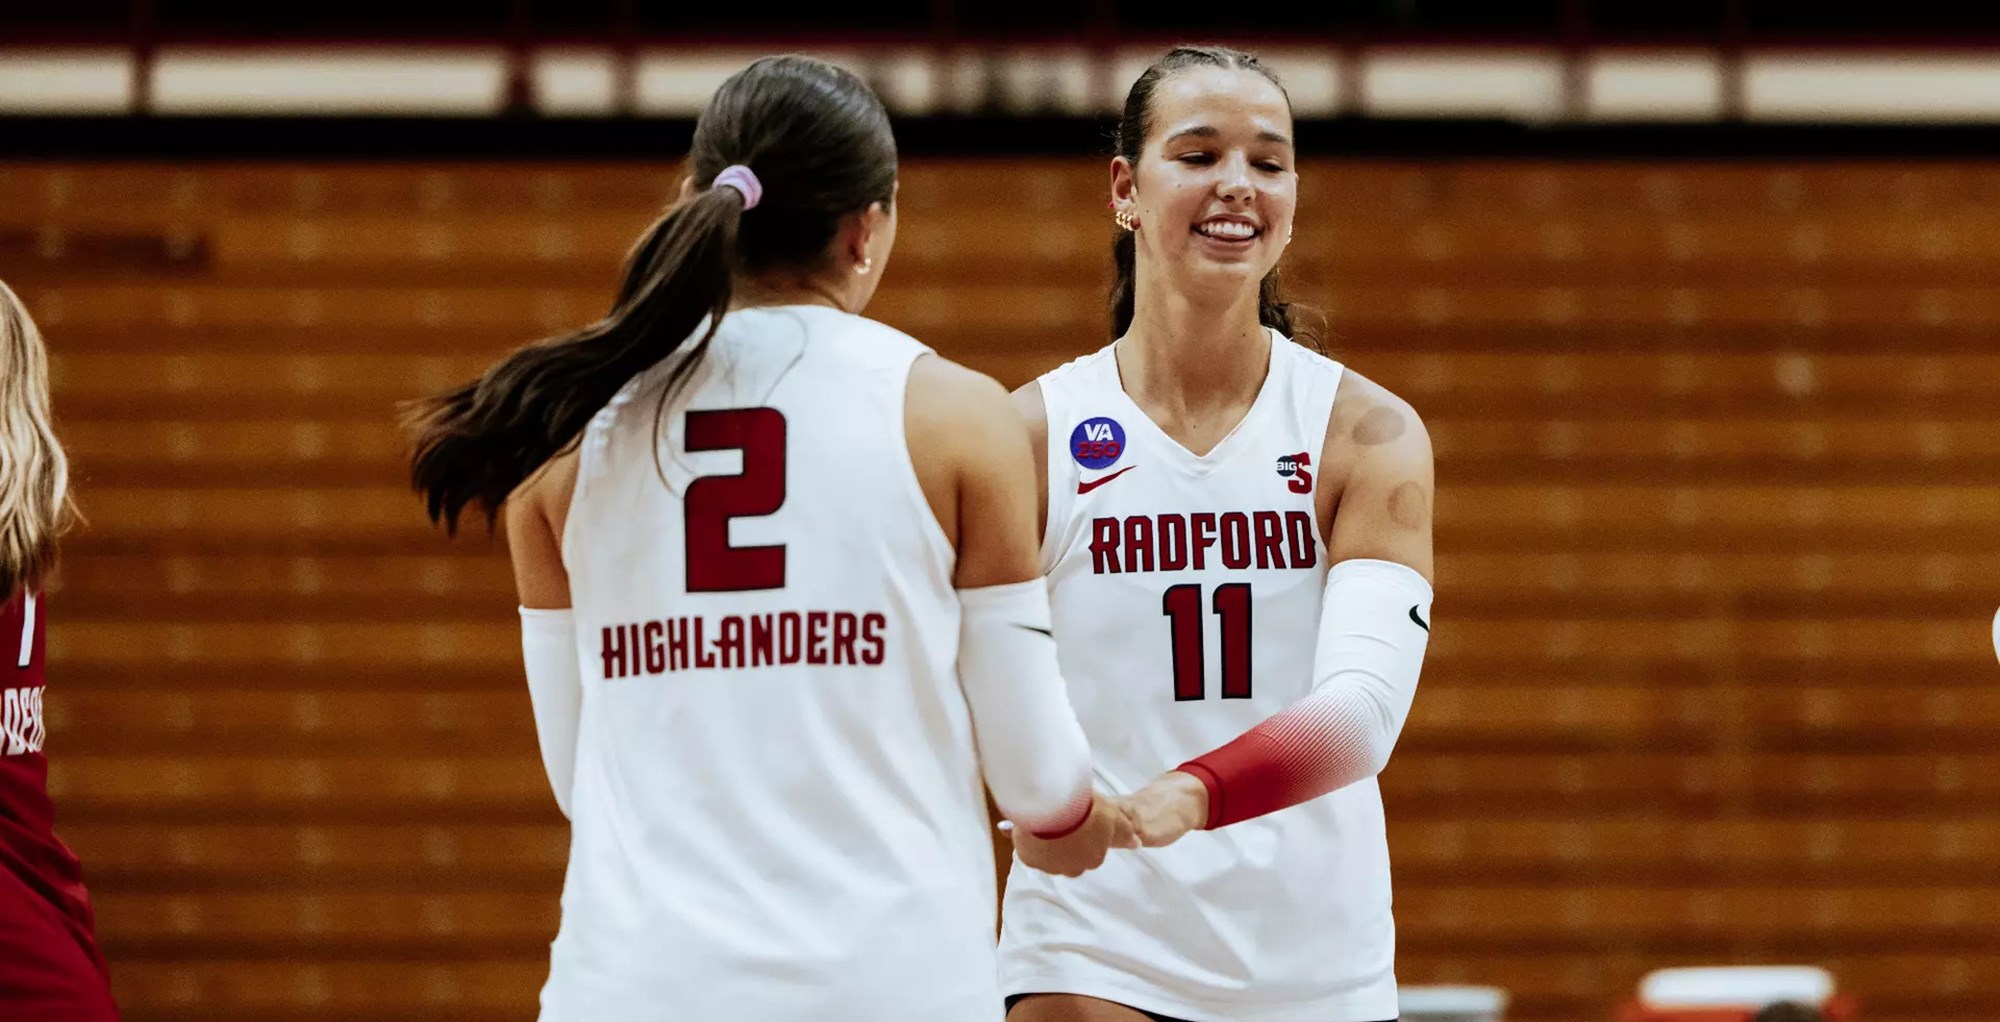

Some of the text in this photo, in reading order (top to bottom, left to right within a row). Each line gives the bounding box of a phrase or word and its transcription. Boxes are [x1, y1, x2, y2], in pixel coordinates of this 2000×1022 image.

[1076, 441, 1120, 459] 250
[1083, 423, 1115, 441] VA
[1276, 461, 1297, 471] BIG
[684, 407, 787, 592] 2
[1088, 511, 1316, 574] RADFORD
[601, 611, 886, 679] HIGHLANDERS
[1162, 583, 1252, 702] 11
